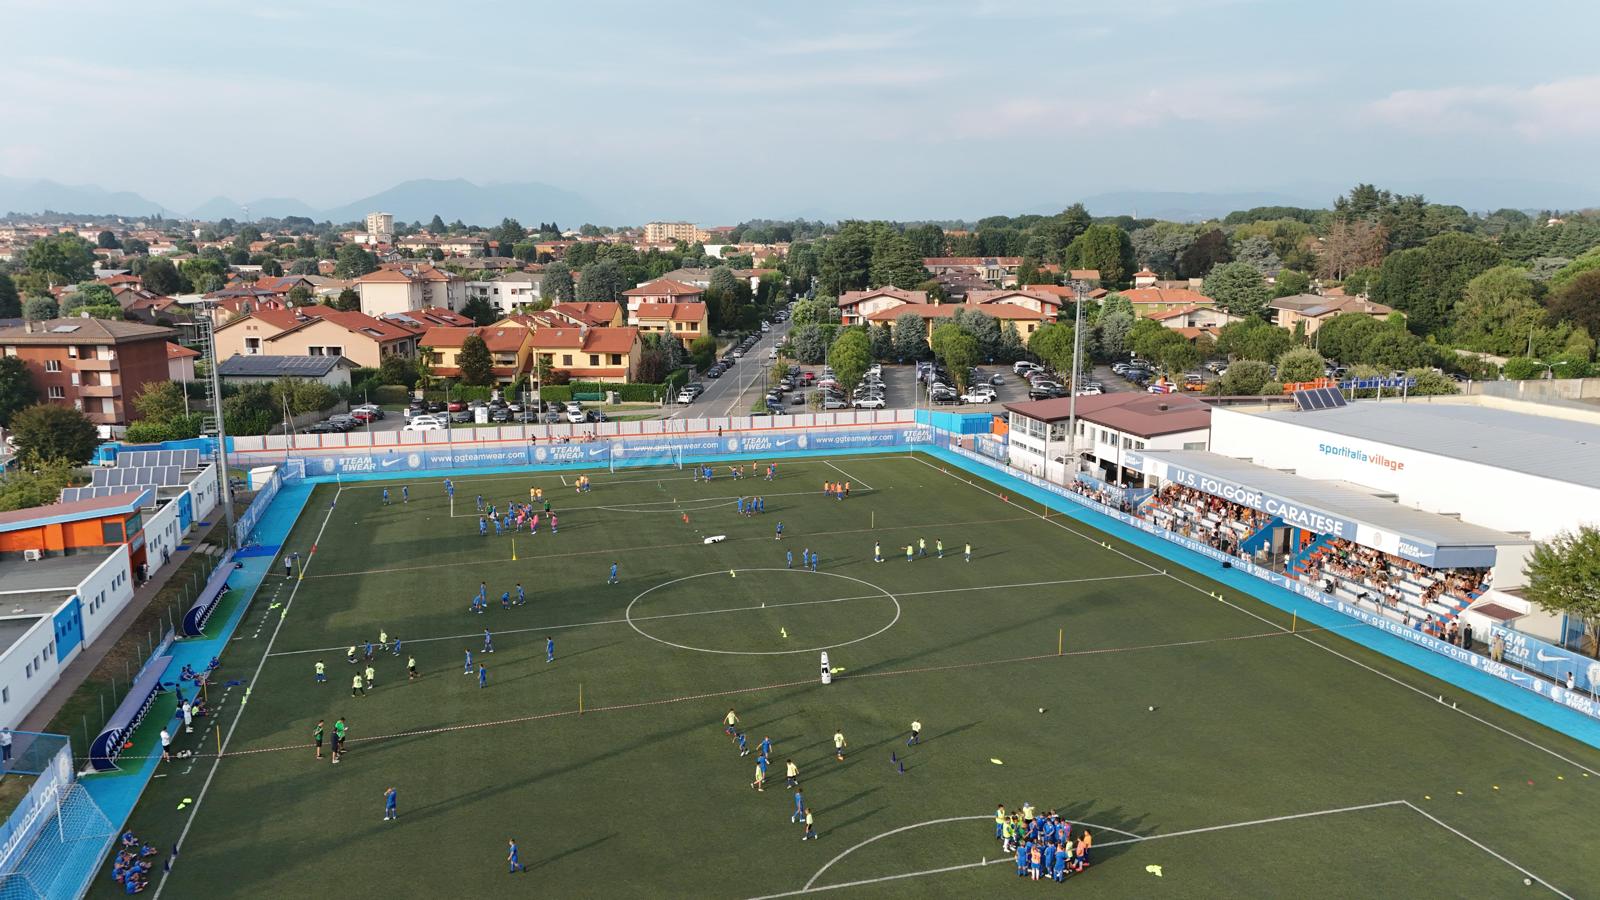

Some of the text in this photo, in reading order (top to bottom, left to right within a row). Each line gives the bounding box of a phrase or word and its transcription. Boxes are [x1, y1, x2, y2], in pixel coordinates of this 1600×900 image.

[816, 434, 894, 444] www.ggteamwear.com
[430, 451, 526, 463] www.ggteamwear.com
[1319, 443, 1405, 471] sportitalia village
[1177, 470, 1344, 536] U.S. FOLGORE CARATESE
[1170, 534, 1247, 570] www.ggteamwear.com
[1345, 605, 1468, 661] www.ggteamwear.com
[1504, 641, 1530, 659] EAR
